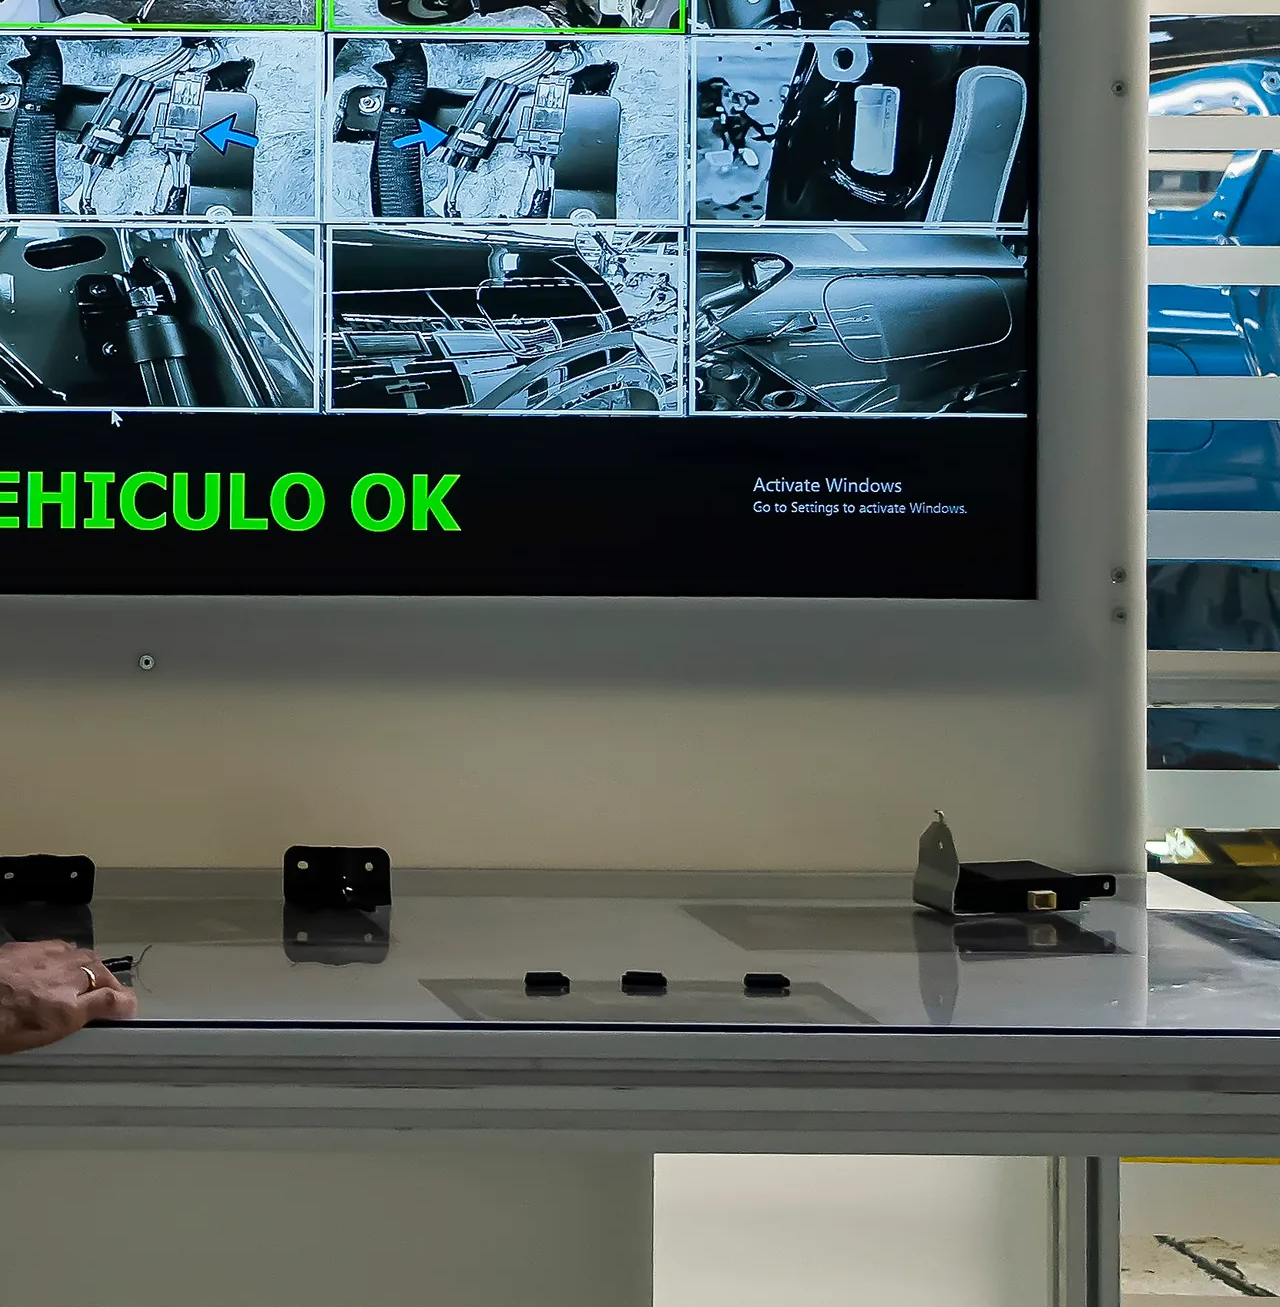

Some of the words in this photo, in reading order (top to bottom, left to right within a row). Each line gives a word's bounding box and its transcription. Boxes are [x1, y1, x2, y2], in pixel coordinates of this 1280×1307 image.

[752, 476, 821, 493] Activate
[825, 477, 903, 493] Windows
[351, 472, 461, 533] OK
[752, 500, 771, 514] Go
[774, 502, 788, 514] to
[790, 500, 840, 517] Settings
[842, 502, 856, 514] to
[858, 501, 907, 514] activate
[909, 501, 968, 515] Windows.
